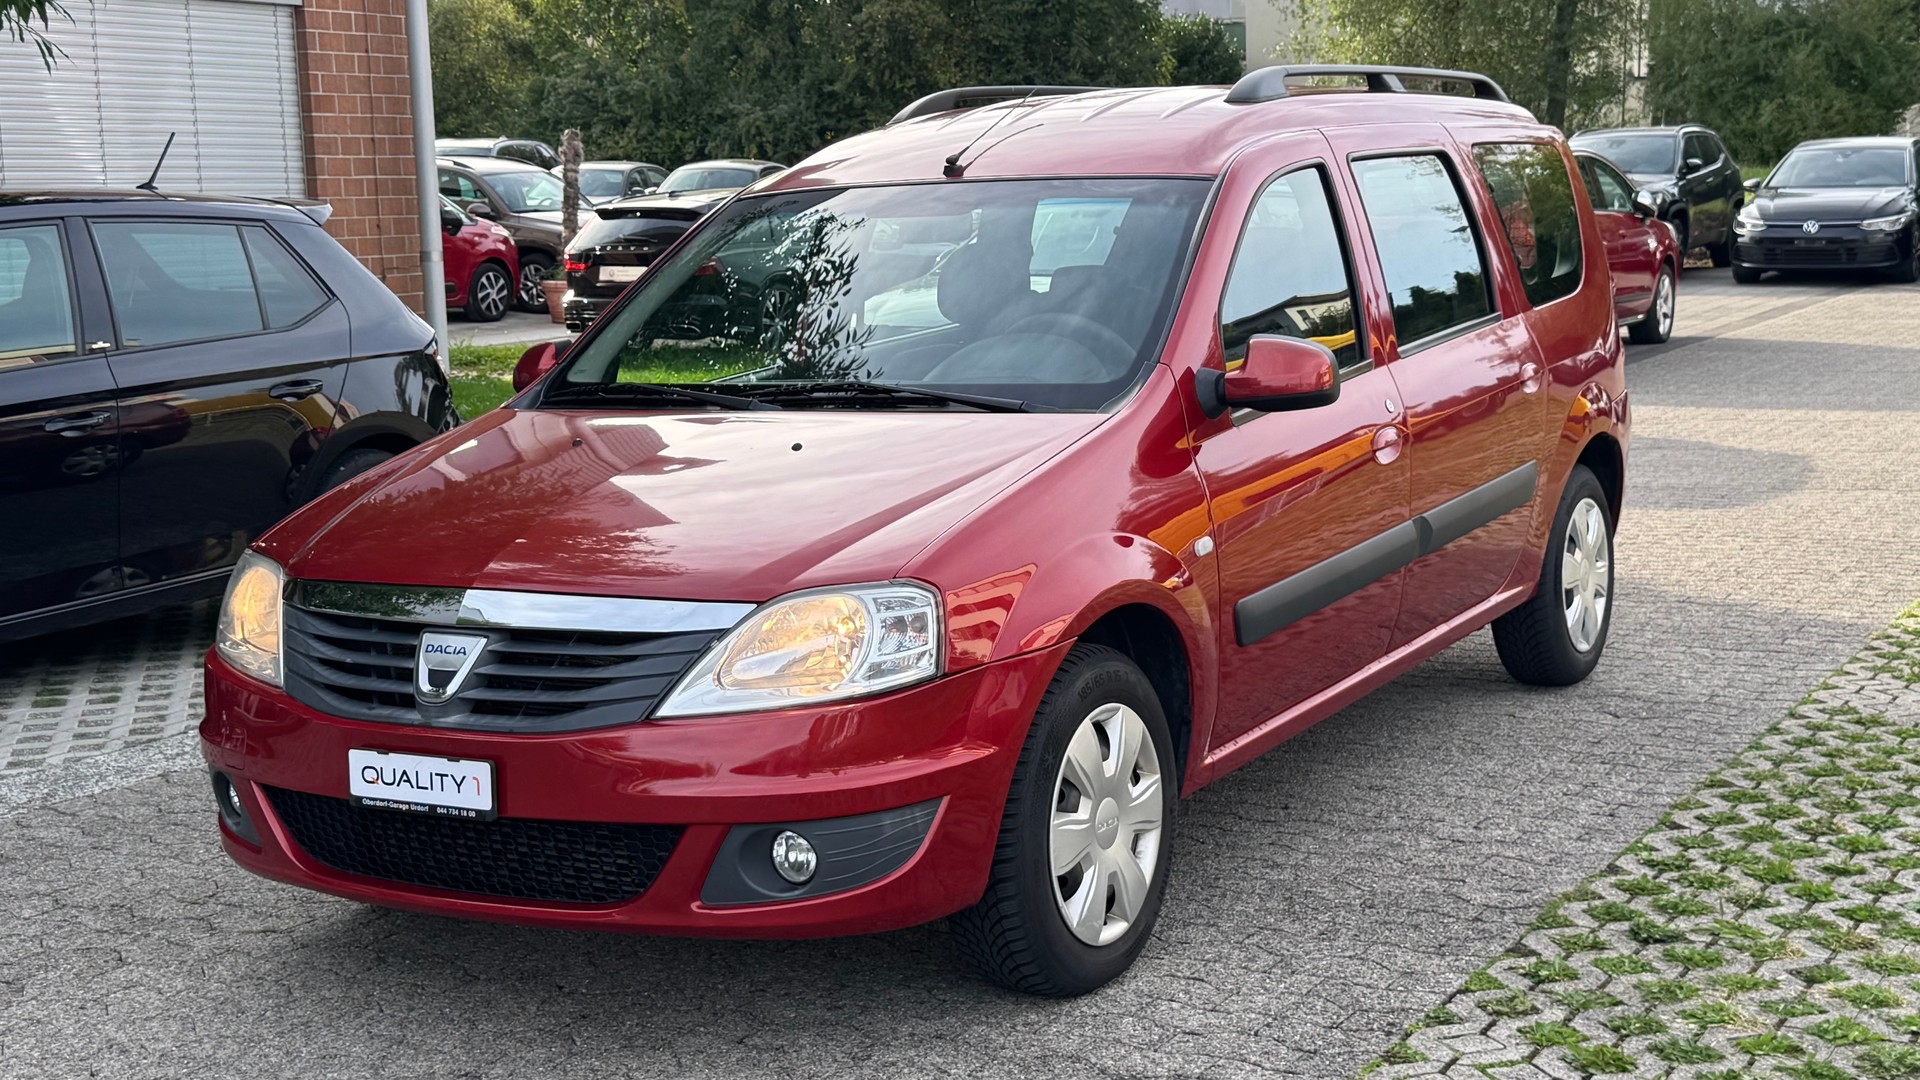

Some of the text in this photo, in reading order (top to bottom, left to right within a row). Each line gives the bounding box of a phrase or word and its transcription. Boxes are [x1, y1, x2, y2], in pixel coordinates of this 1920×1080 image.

[425, 644, 467, 656] DACIA
[361, 766, 467, 794] QUALITY
[362, 798, 409, 810] Oberdorf-Garage
[410, 803, 429, 812] Urdorf
[436, 806, 447, 814] 044
[448, 808, 459, 816] 734
[460, 809, 468, 817] 18
